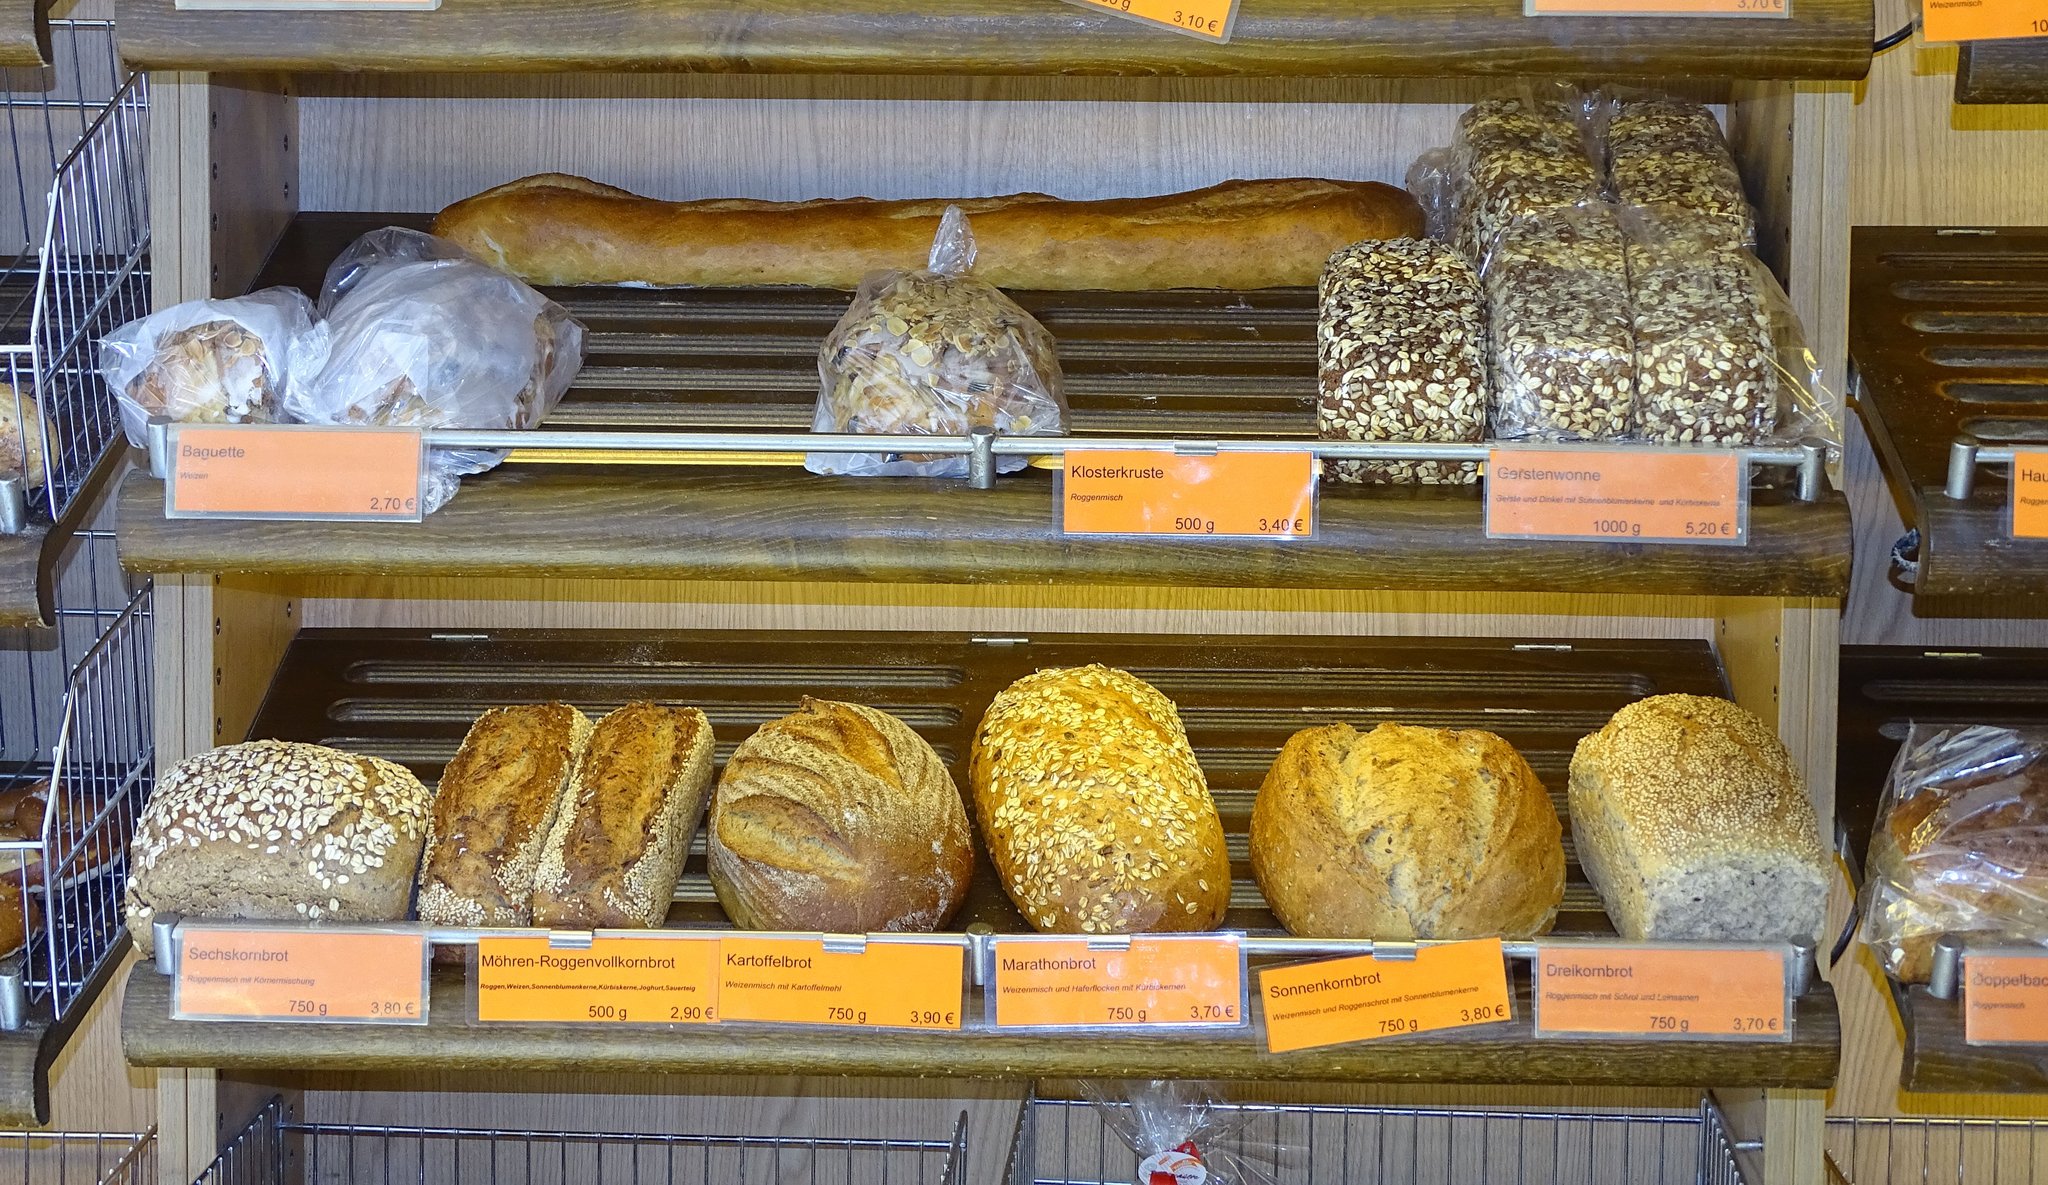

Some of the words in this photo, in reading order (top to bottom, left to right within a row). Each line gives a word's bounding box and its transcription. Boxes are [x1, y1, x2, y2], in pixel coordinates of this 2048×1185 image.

[1930, 0, 1983, 8] Weizenmisch
[1173, 10, 1205, 28] 3,10
[1208, 19, 1219, 32] €
[182, 444, 245, 460] Baguette
[180, 471, 209, 479] Weizen
[1071, 465, 1164, 480] Klosterkruste
[1497, 466, 1602, 482] Gerstenwonne
[370, 497, 401, 513] 2,70
[405, 497, 414, 510] €
[1070, 493, 1123, 502] Roggenmisch
[1523, 495, 1538, 503] und
[1659, 498, 1674, 506] und
[1175, 517, 1201, 531] 500
[1206, 520, 1215, 533] g
[1259, 518, 1290, 533] 3,40
[1294, 519, 1304, 532] €
[1593, 520, 1628, 533] 1000
[1632, 523, 1641, 537] g
[1685, 521, 1717, 536] 5,20
[1720, 521, 1731, 535] €
[189, 947, 289, 962] Sechskornbrot
[726, 953, 812, 969] Kartoffelbrot
[481, 954, 676, 971] Möhren-Roggenvollkornbrot
[1003, 958, 1096, 971] Marathonbrot
[1546, 964, 1633, 978] Dreikornbrot
[187, 975, 239, 985] Roggenmisch
[240, 975, 252, 983] mit
[725, 980, 776, 990] Weizenmisch
[777, 982, 789, 990] mit
[790, 983, 842, 992] Kartoffelmehl
[1270, 972, 1382, 999] Sonnenkornbrot
[1003, 985, 1053, 994] Weizenmisch
[1055, 985, 1070, 993] und
[1072, 984, 1120, 993] Haferflocken
[1122, 984, 1134, 992] mit
[1546, 992, 1598, 1001] Roggenmisch
[1600, 992, 1612, 1000] mit
[1641, 993, 1656, 1001] und
[289, 1000, 315, 1013] 750
[319, 1003, 327, 1016] g
[371, 1001, 401, 1017] 3,80
[405, 1001, 415, 1015] €
[1272, 1008, 1321, 1021] Weizenmisch
[1323, 1005, 1337, 1014] und
[1338, 998, 1390, 1012] Roggenschrot
[1391, 996, 1403, 1004] mit
[1403, 985, 1480, 1003] Sonnenblumenkerne
[588, 1005, 615, 1018] 500
[618, 1008, 627, 1021] g
[670, 1006, 701, 1021] 2,90
[704, 1006, 714, 1020] €
[828, 1007, 854, 1021] 750
[858, 1010, 867, 1024] g
[910, 1010, 941, 1025] 3,90
[945, 1012, 955, 1025] €
[1107, 1007, 1134, 1020] 750
[1138, 1009, 1147, 1022] g
[1190, 1005, 1221, 1019] 3,70
[1225, 1004, 1234, 1018] €
[1460, 1006, 1491, 1023] 3,80
[1495, 1004, 1504, 1018] €
[1378, 1018, 1405, 1033] 750
[1409, 1019, 1418, 1033] g
[1650, 1016, 1676, 1030] 750
[1680, 1019, 1689, 1033] g
[1733, 1017, 1764, 1032] 3,70
[1767, 1017, 1778, 1030] €
